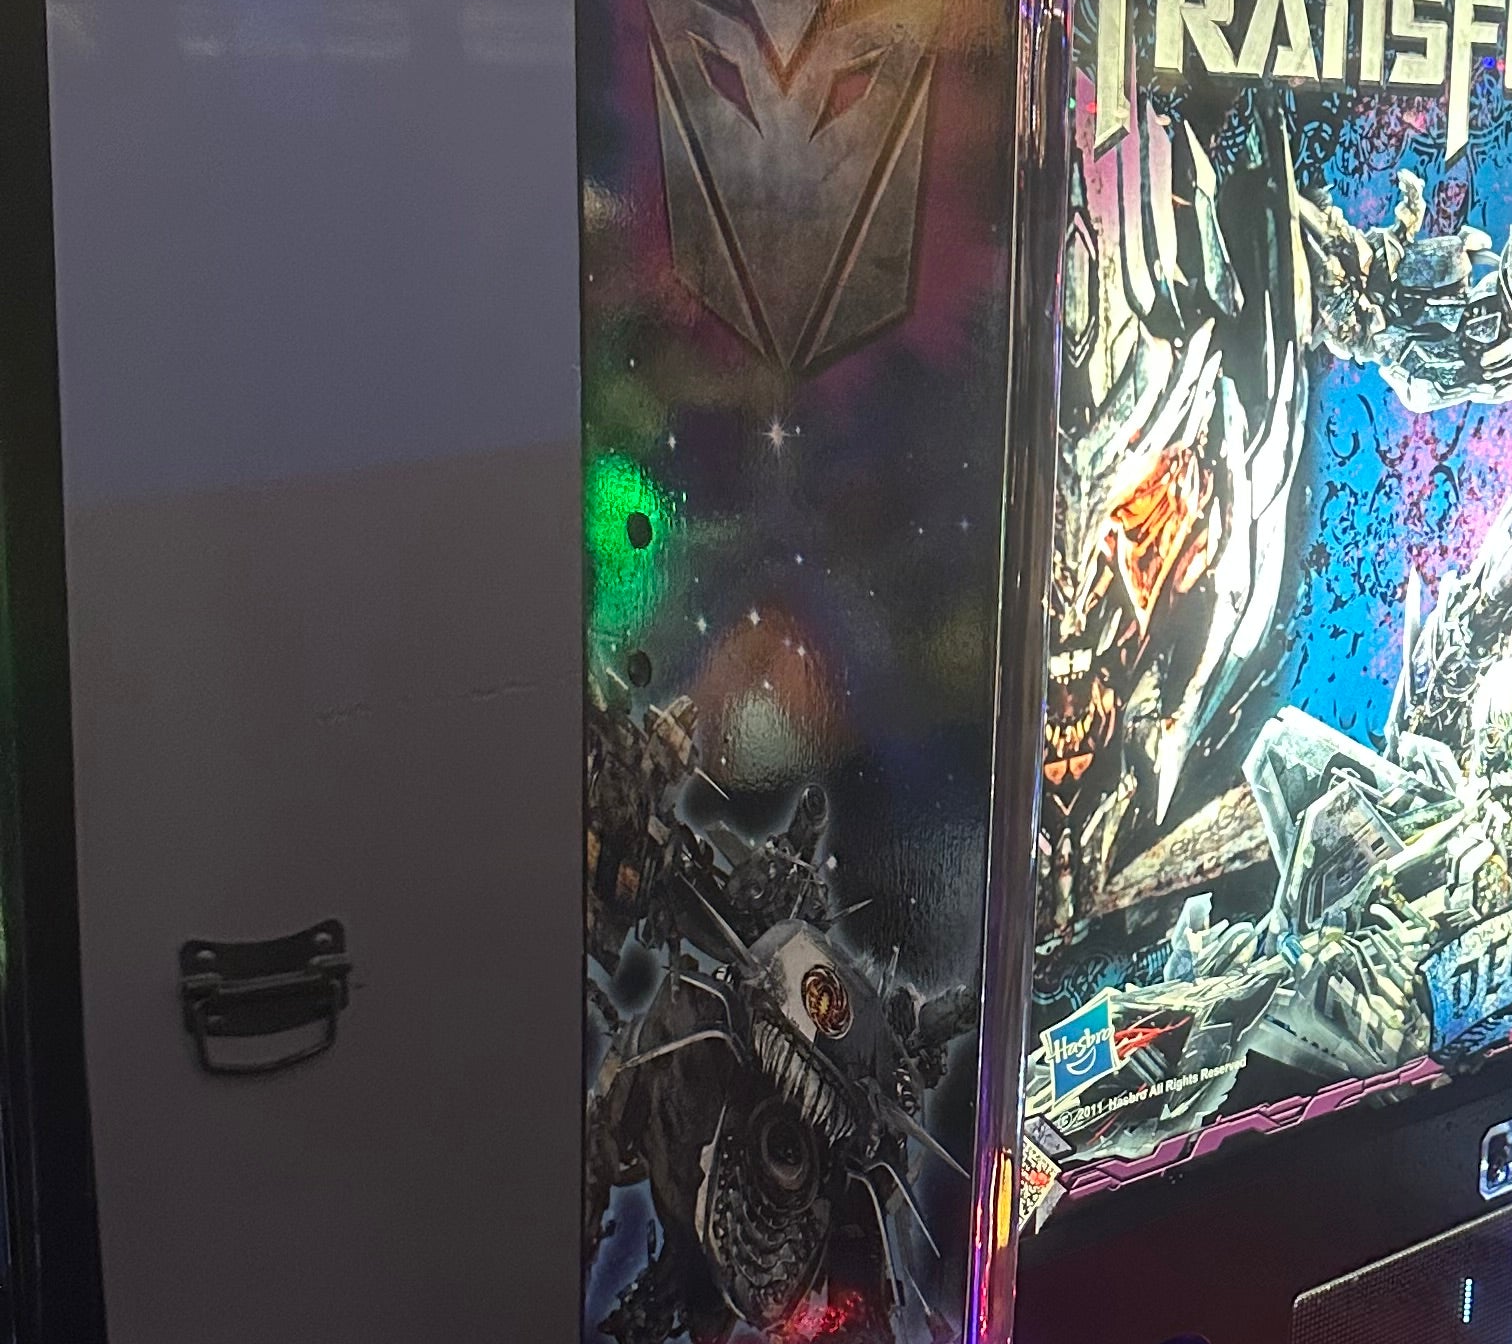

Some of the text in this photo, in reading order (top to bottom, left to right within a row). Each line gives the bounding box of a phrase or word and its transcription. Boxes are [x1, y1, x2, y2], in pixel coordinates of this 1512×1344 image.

[1050, 1023, 1116, 1065] Hasbro
[1076, 1101, 1104, 1121] 2011
[1108, 1088, 1148, 1112] Hasbro
[1148, 1081, 1165, 1098] All
[1165, 1071, 1199, 1094] Rights
[1199, 1056, 1248, 1081] Reserved
